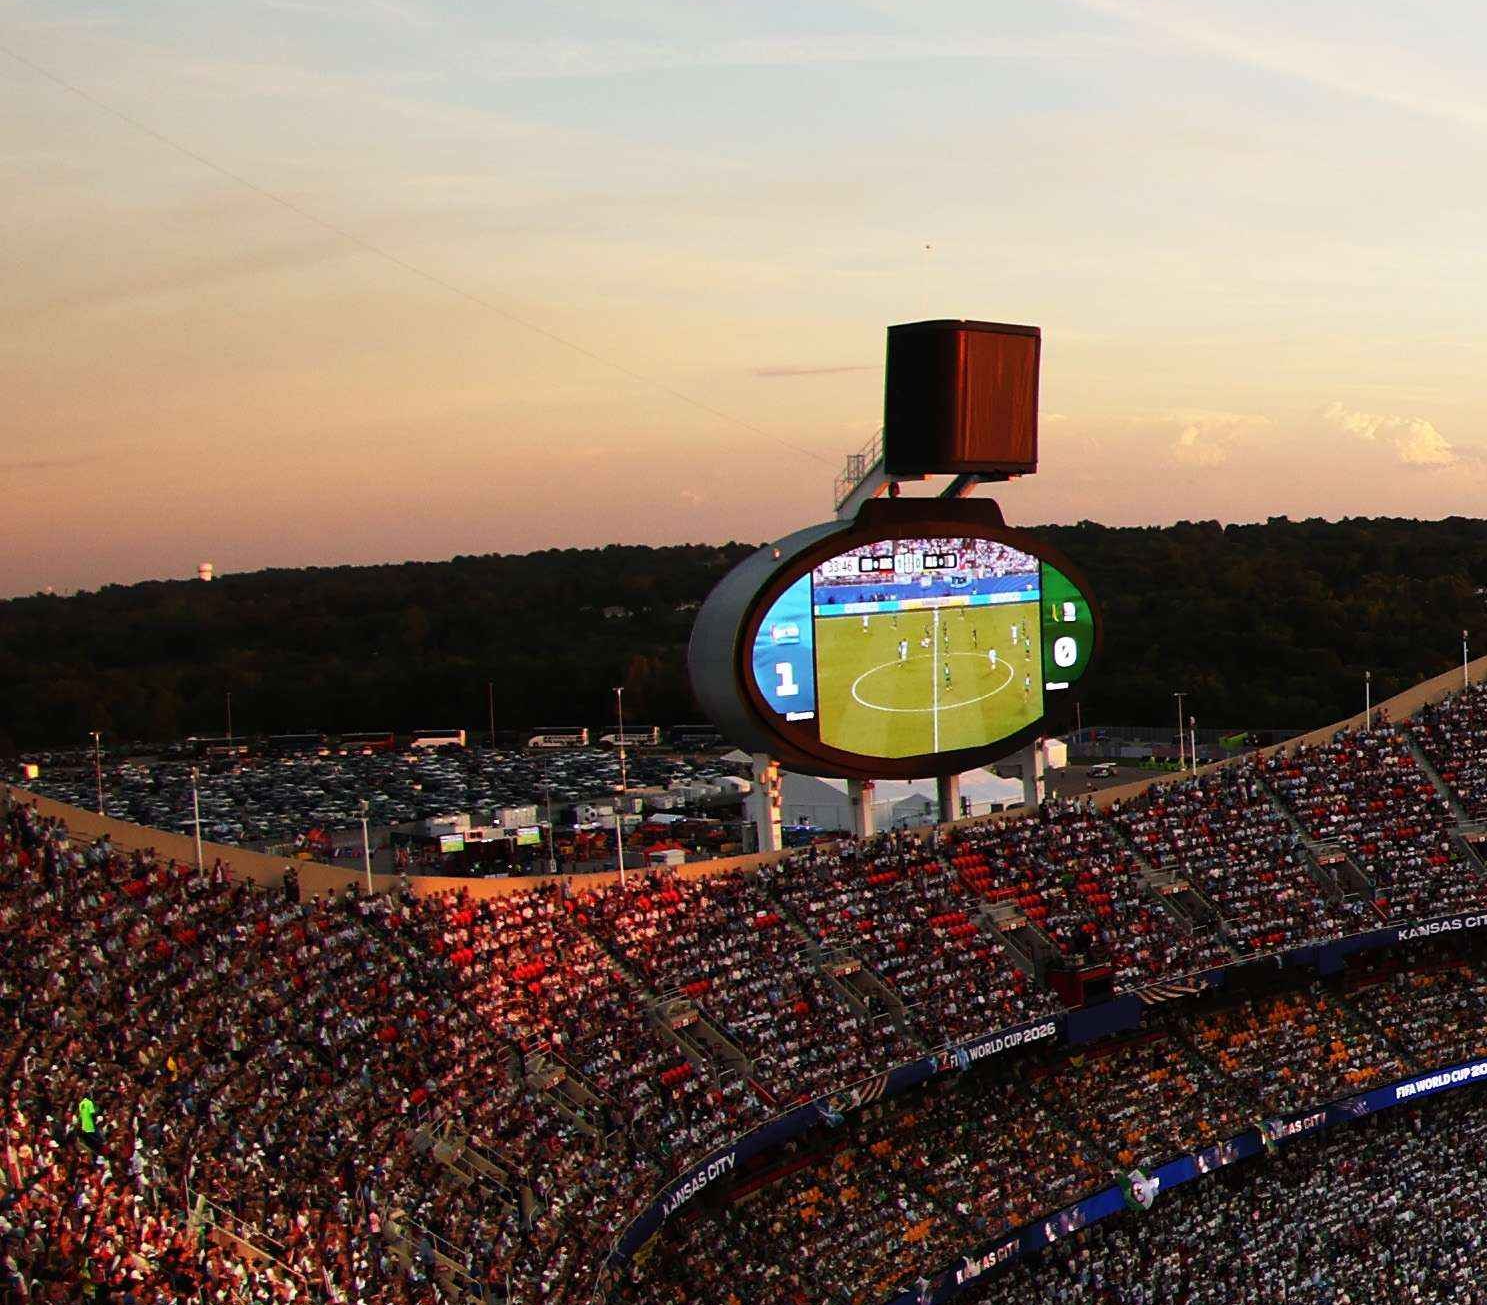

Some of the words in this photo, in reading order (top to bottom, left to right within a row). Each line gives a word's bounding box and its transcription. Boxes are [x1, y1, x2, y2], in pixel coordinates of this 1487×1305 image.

[1054, 636, 1077, 668] 0
[776, 662, 799, 697] 1
[1398, 918, 1463, 941] KANSAS
[969, 1039, 1003, 1061] WORLD
[1004, 1032, 1023, 1049] CUP
[1023, 1022, 1056, 1043] 2026
[1396, 1083, 1415, 1099] FIFA
[1415, 1075, 1449, 1096] WORLD
[1450, 1066, 1470, 1085] CUP
[707, 1152, 736, 1184] CITY
